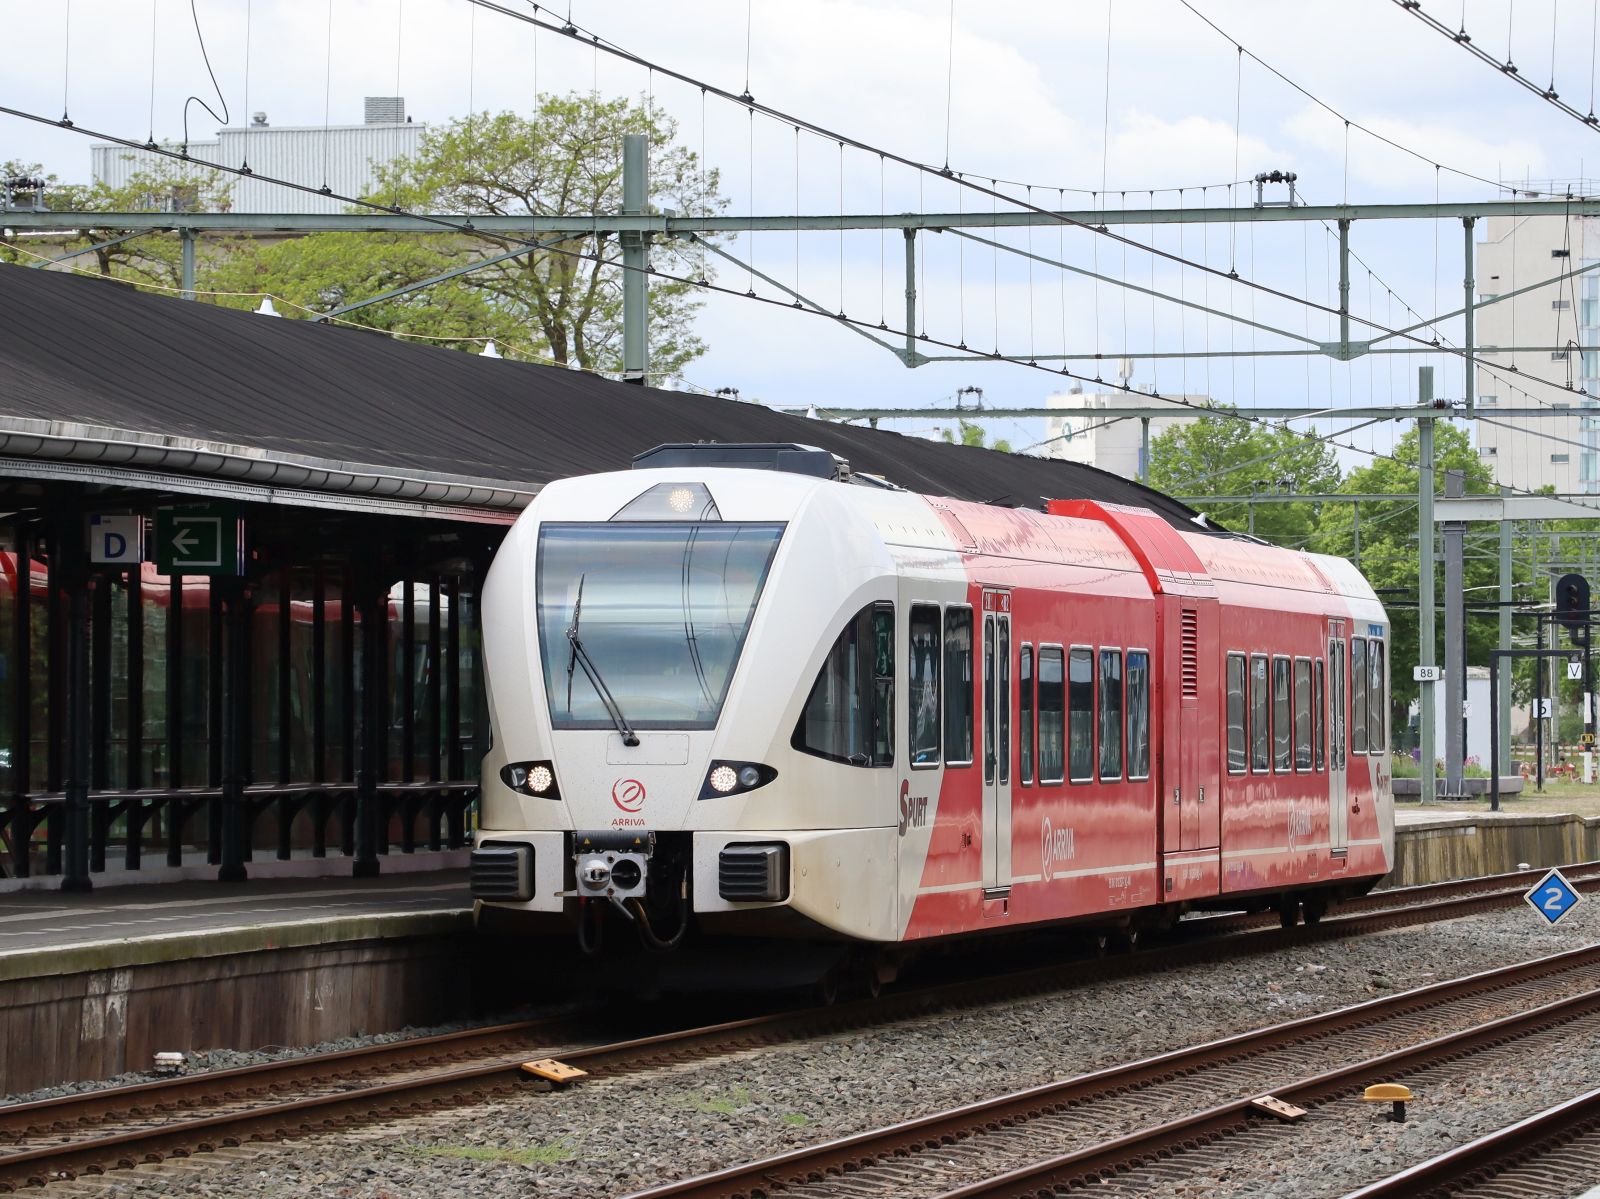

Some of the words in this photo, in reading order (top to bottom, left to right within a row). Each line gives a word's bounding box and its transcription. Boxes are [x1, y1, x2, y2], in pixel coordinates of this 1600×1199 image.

[104, 532, 127, 558] D
[1420, 668, 1433, 678] 88
[1569, 664, 1580, 678] V
[611, 818, 646, 826] ARRIVA
[1053, 827, 1075, 860] ARRIVA
[1544, 887, 1563, 910] 2
